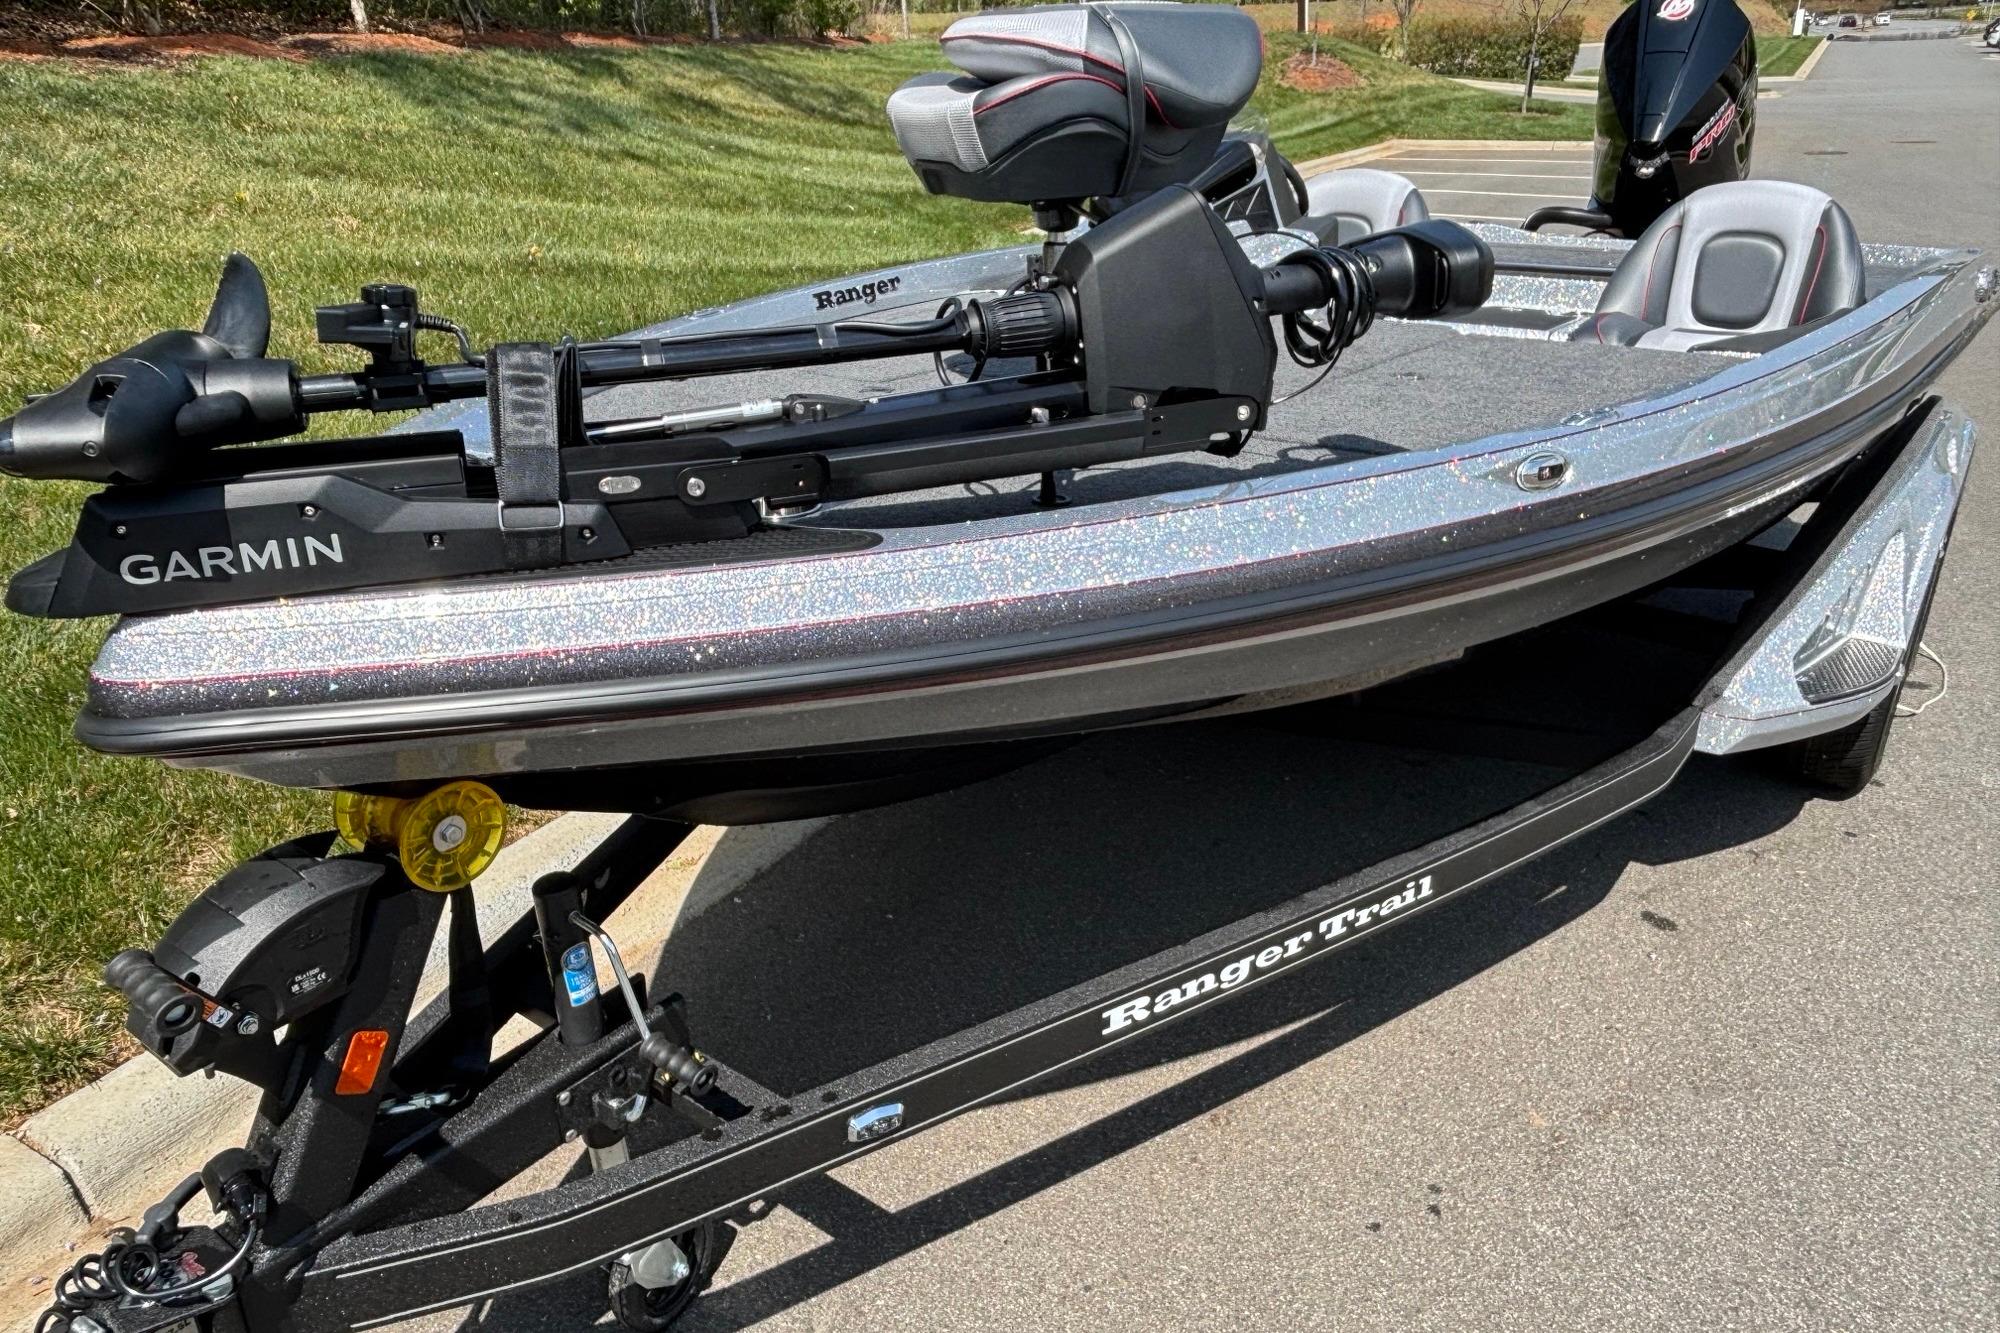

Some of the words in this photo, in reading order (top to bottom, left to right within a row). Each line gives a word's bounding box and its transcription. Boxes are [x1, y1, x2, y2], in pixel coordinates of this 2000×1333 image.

[812, 276, 901, 310] Ranger
[120, 533, 344, 585] GARMIN
[1102, 931, 1312, 1035] Ranger
[1319, 875, 1433, 940] Trail
